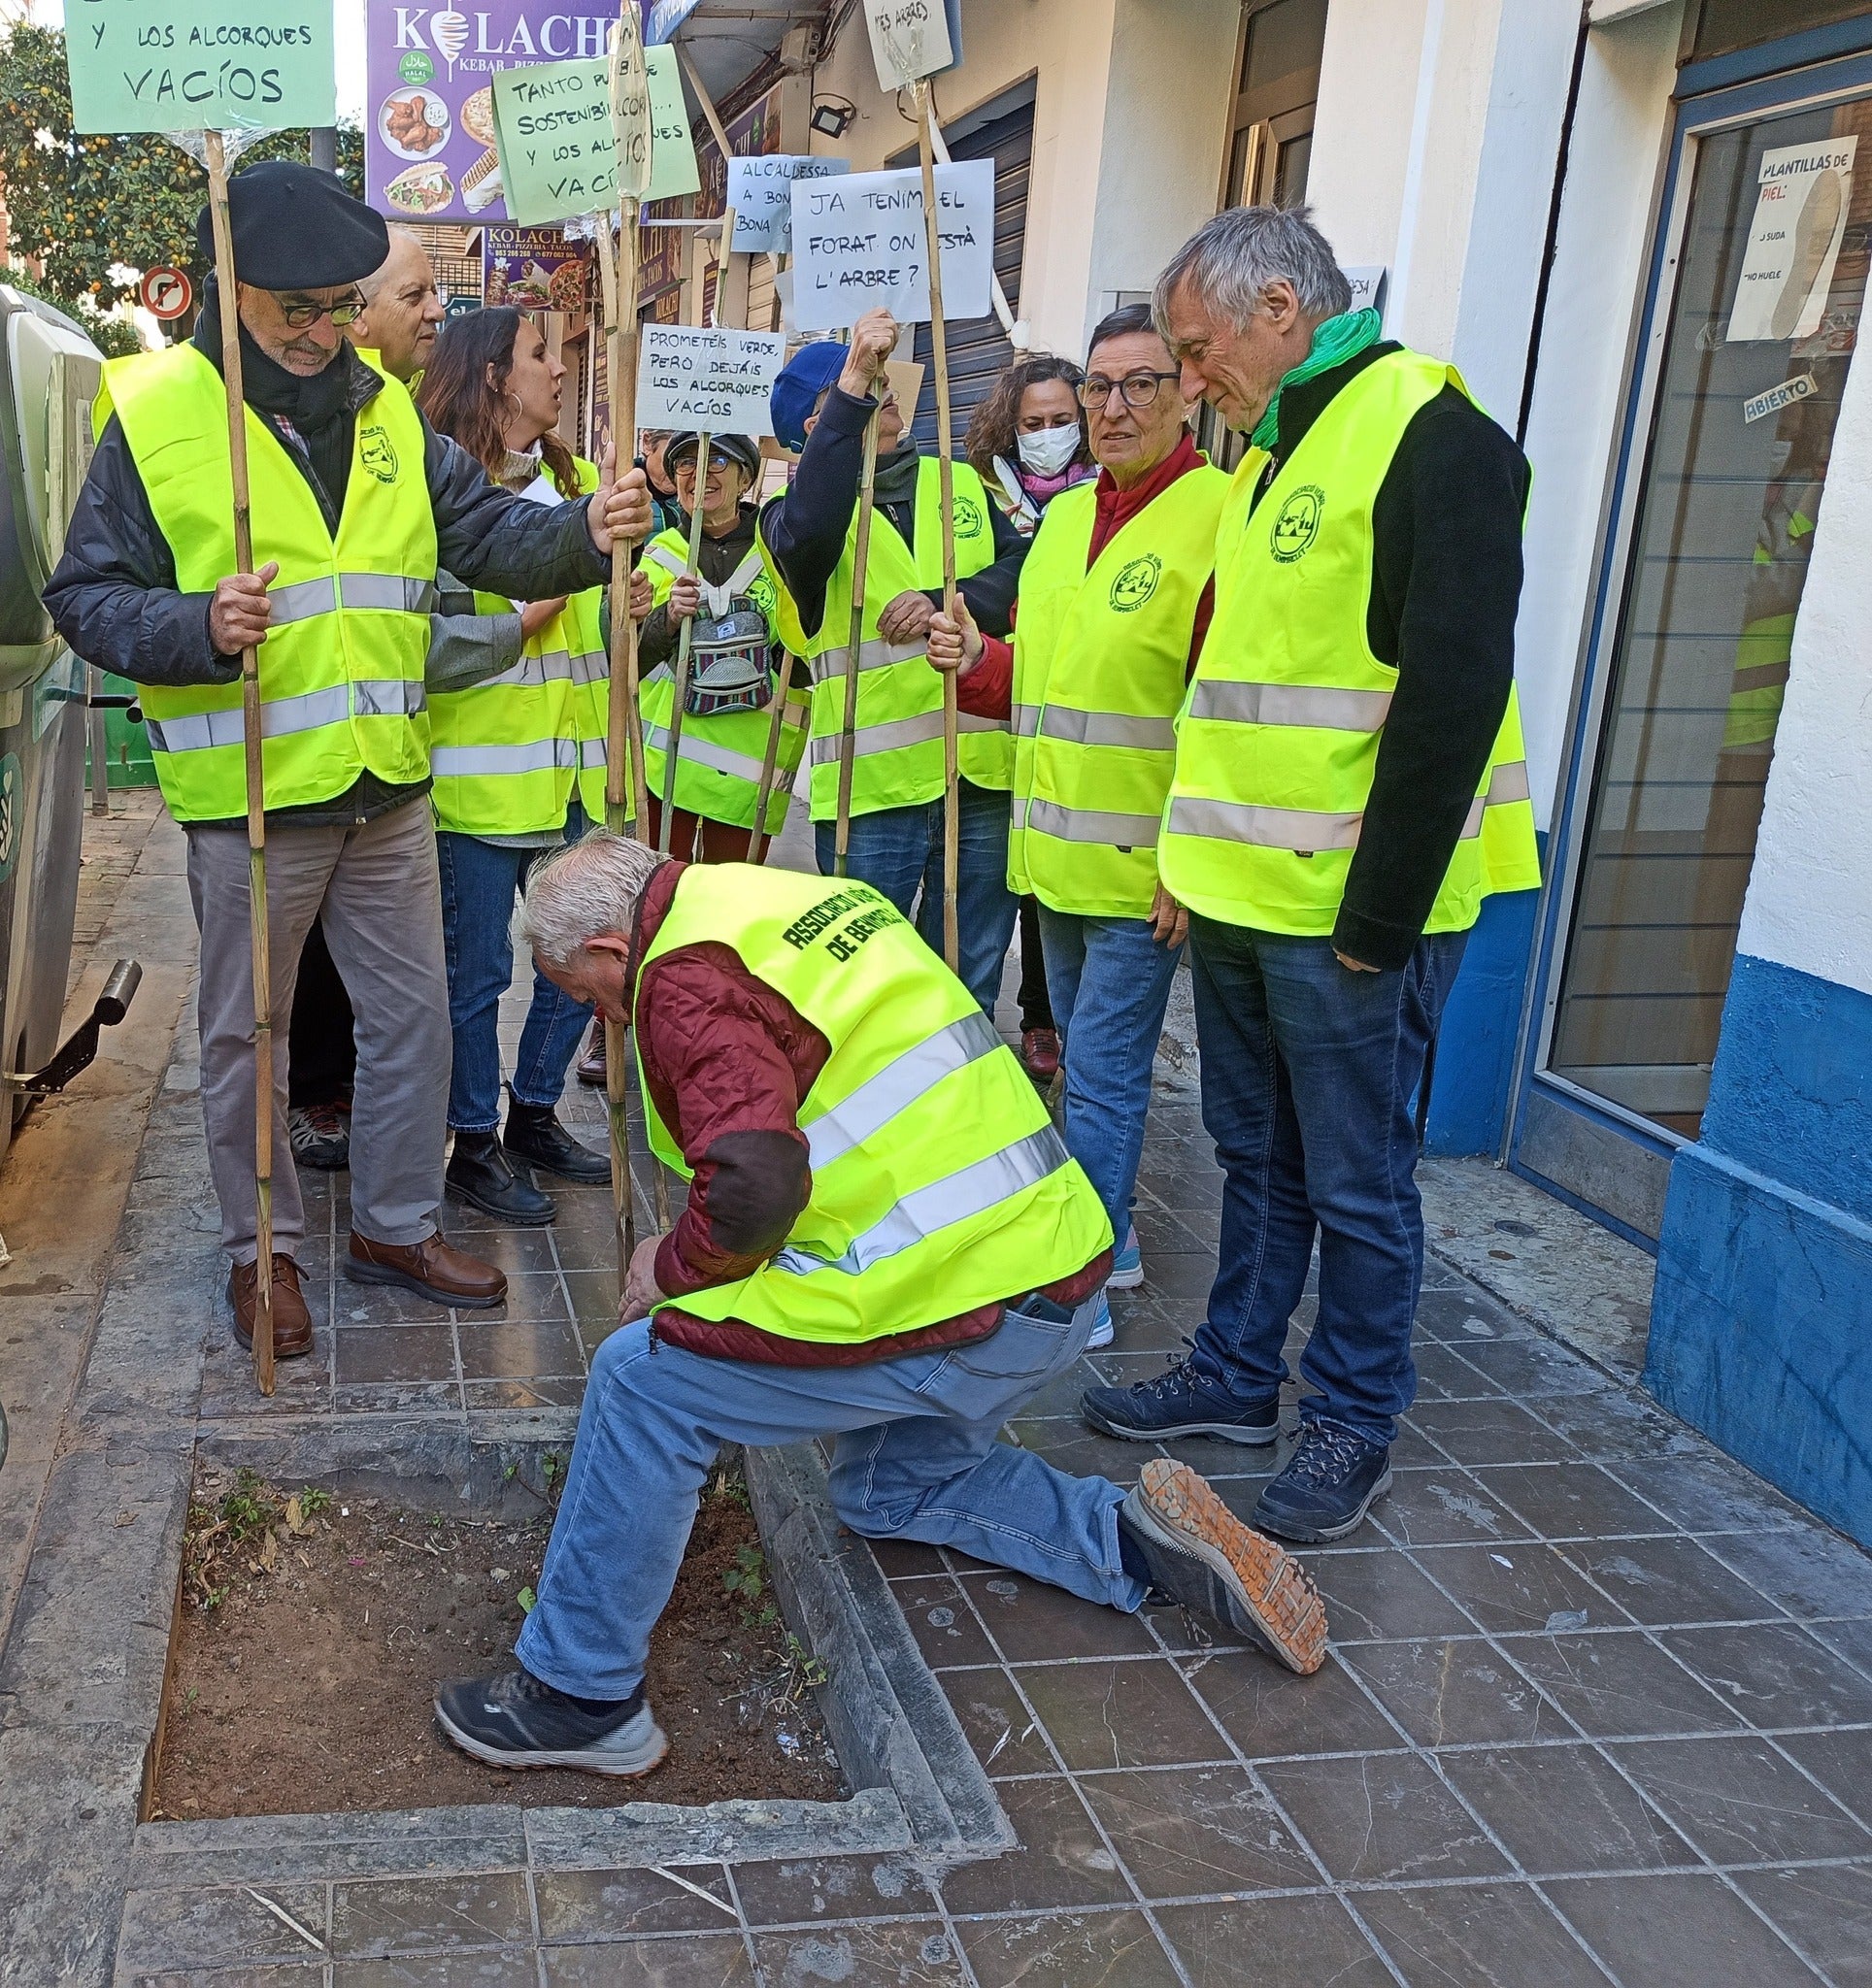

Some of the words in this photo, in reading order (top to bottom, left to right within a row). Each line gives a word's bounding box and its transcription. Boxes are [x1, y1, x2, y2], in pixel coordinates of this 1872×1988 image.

[91, 21, 106, 50] Y
[138, 24, 175, 49] LOS
[188, 25, 312, 49] ALCORQUES
[123, 59, 284, 103] VACÍOS
[512, 76, 584, 103] TANTO
[526, 149, 537, 166] Y
[552, 144, 582, 161] LOS
[1762, 154, 1832, 179] PLANTILLAS
[1833, 153, 1849, 168] DE
[743, 188, 752, 202] A
[810, 193, 845, 215] JA
[861, 190, 923, 211] TENIM
[939, 191, 965, 209] EL
[736, 215, 770, 234] BONA
[888, 233, 916, 251] ON
[1757, 270, 1783, 281] HUELE
[650, 353, 693, 371] PERO
[709, 360, 761, 376] DEJÁIS
[652, 377, 679, 388] LOS
[689, 381, 769, 398] ALCORQUES
[1747, 380, 1808, 418] ABIERTO
[666, 398, 732, 416] VACÍOS
[824, 934, 858, 963] DE
